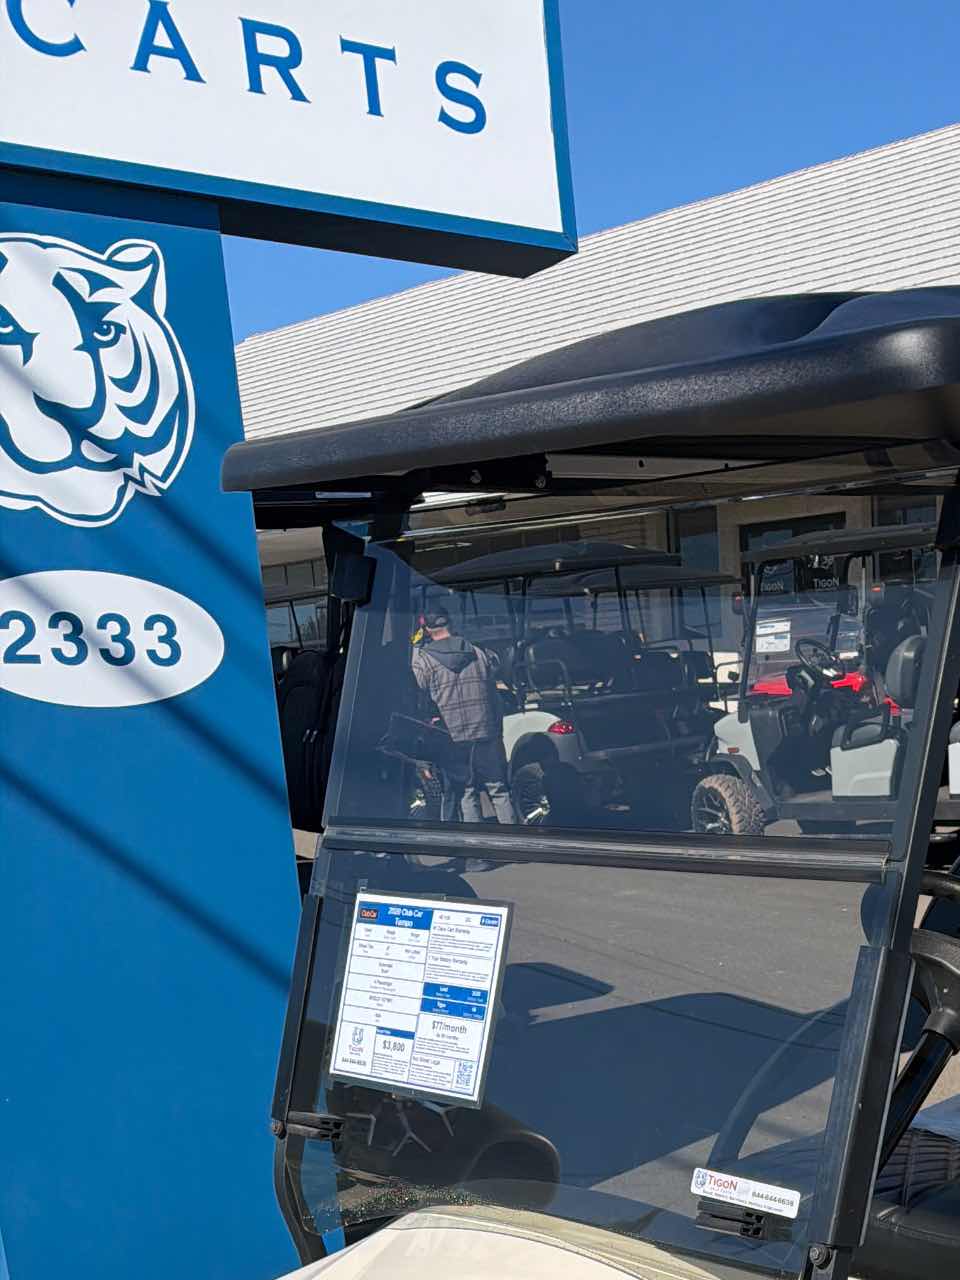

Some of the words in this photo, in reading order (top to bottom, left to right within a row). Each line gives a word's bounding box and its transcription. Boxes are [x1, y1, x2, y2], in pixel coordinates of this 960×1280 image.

[7, 0, 487, 135] CARTS
[813, 577, 840, 588] TIGON
[0, 610, 182, 667] 2333
[708, 1174, 738, 1191] TIGON
